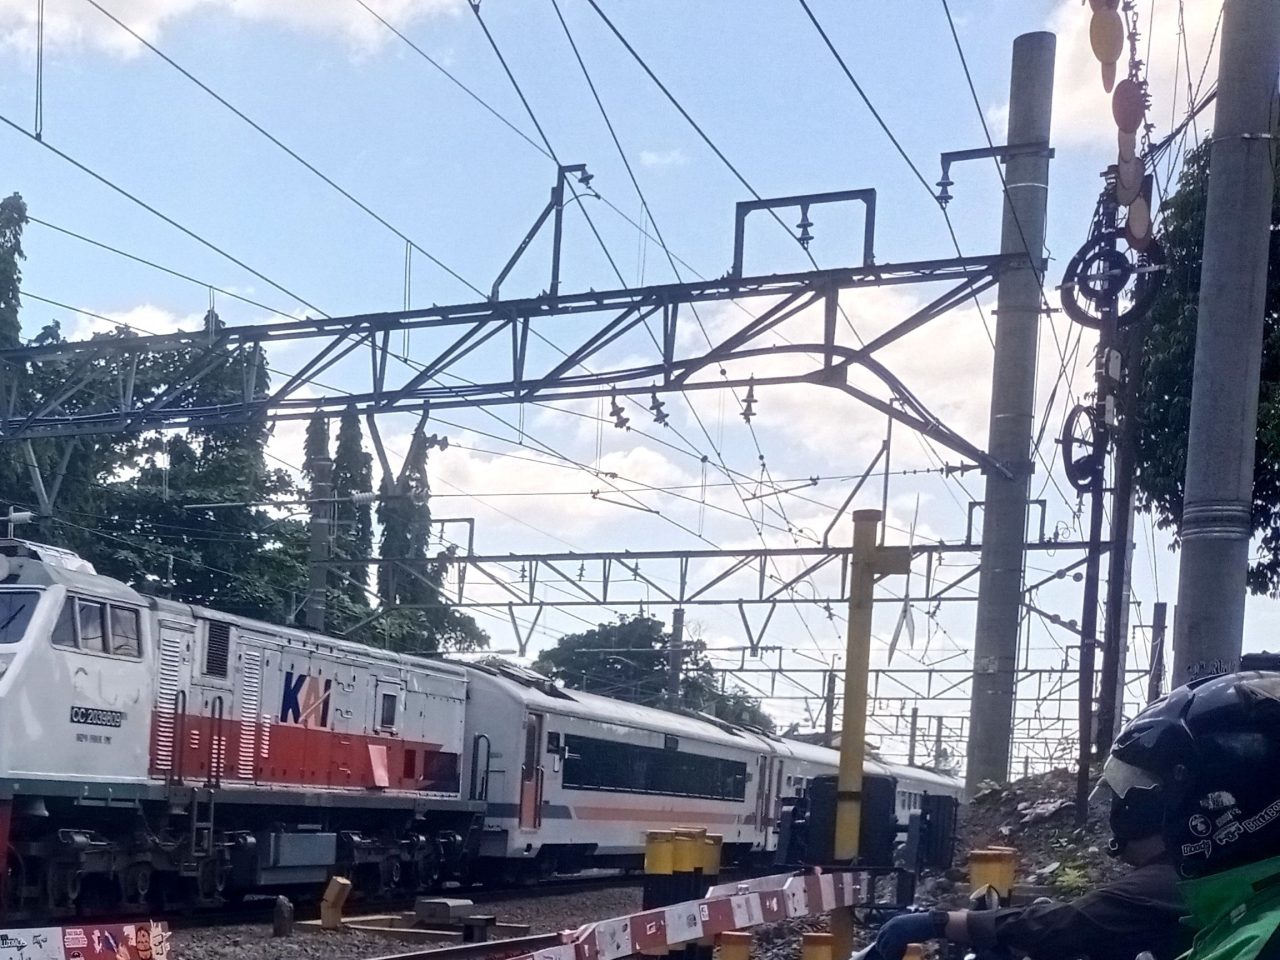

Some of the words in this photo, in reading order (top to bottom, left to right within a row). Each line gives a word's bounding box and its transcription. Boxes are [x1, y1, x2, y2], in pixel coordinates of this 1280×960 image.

[281, 671, 332, 728] KAI
[72, 708, 86, 723] CC
[1245, 802, 1280, 831] BILLABO
